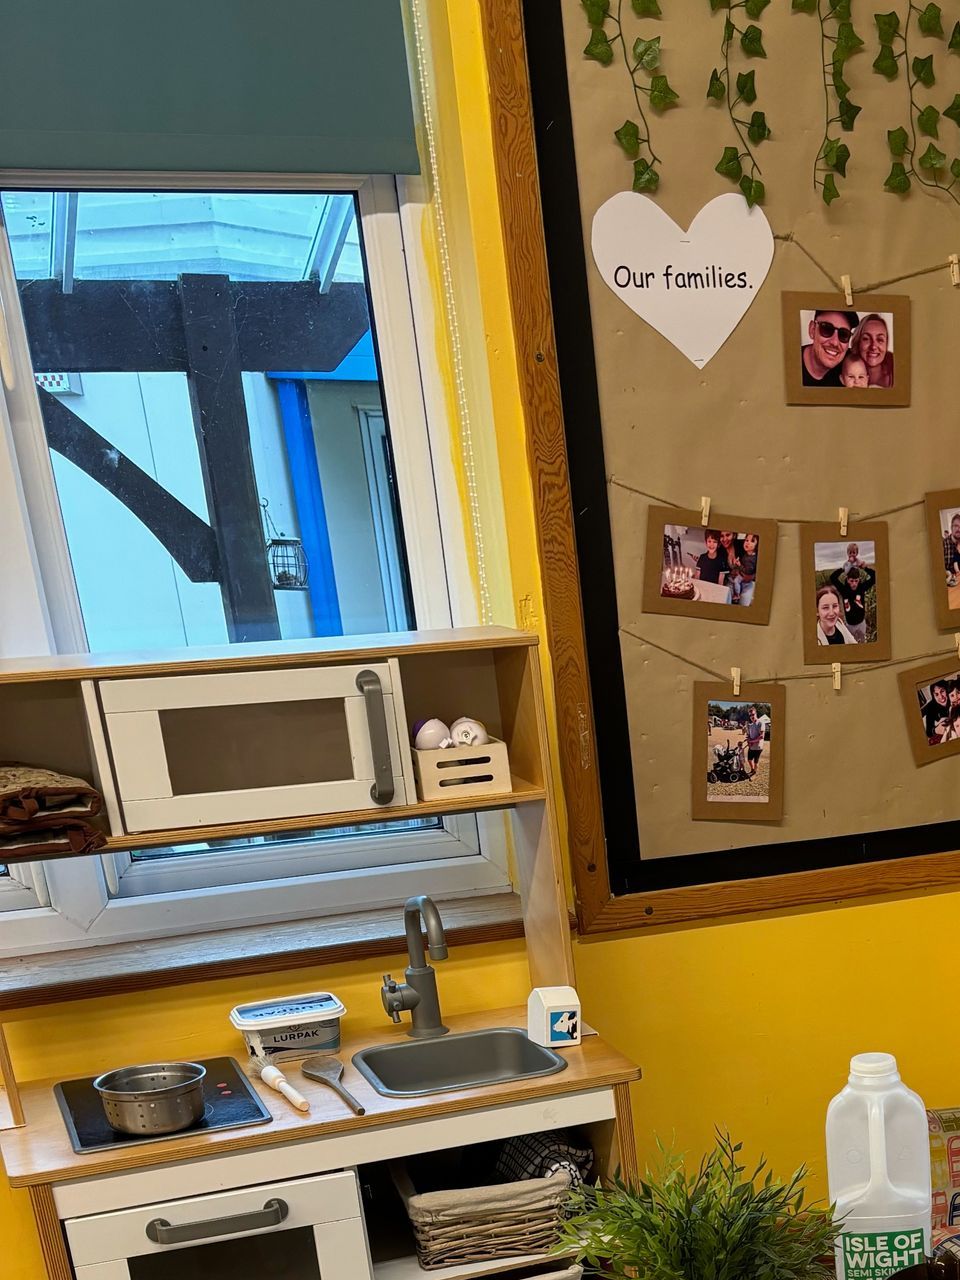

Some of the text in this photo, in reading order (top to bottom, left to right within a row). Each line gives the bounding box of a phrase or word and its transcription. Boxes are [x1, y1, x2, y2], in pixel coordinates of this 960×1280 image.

[614, 264, 753, 290] Our families.
[273, 1029, 320, 1043] LURPAK
[845, 1232, 922, 1252] ISLE OF
[845, 1248, 923, 1269] WIGHT
[847, 1269, 873, 1278] SEMI
